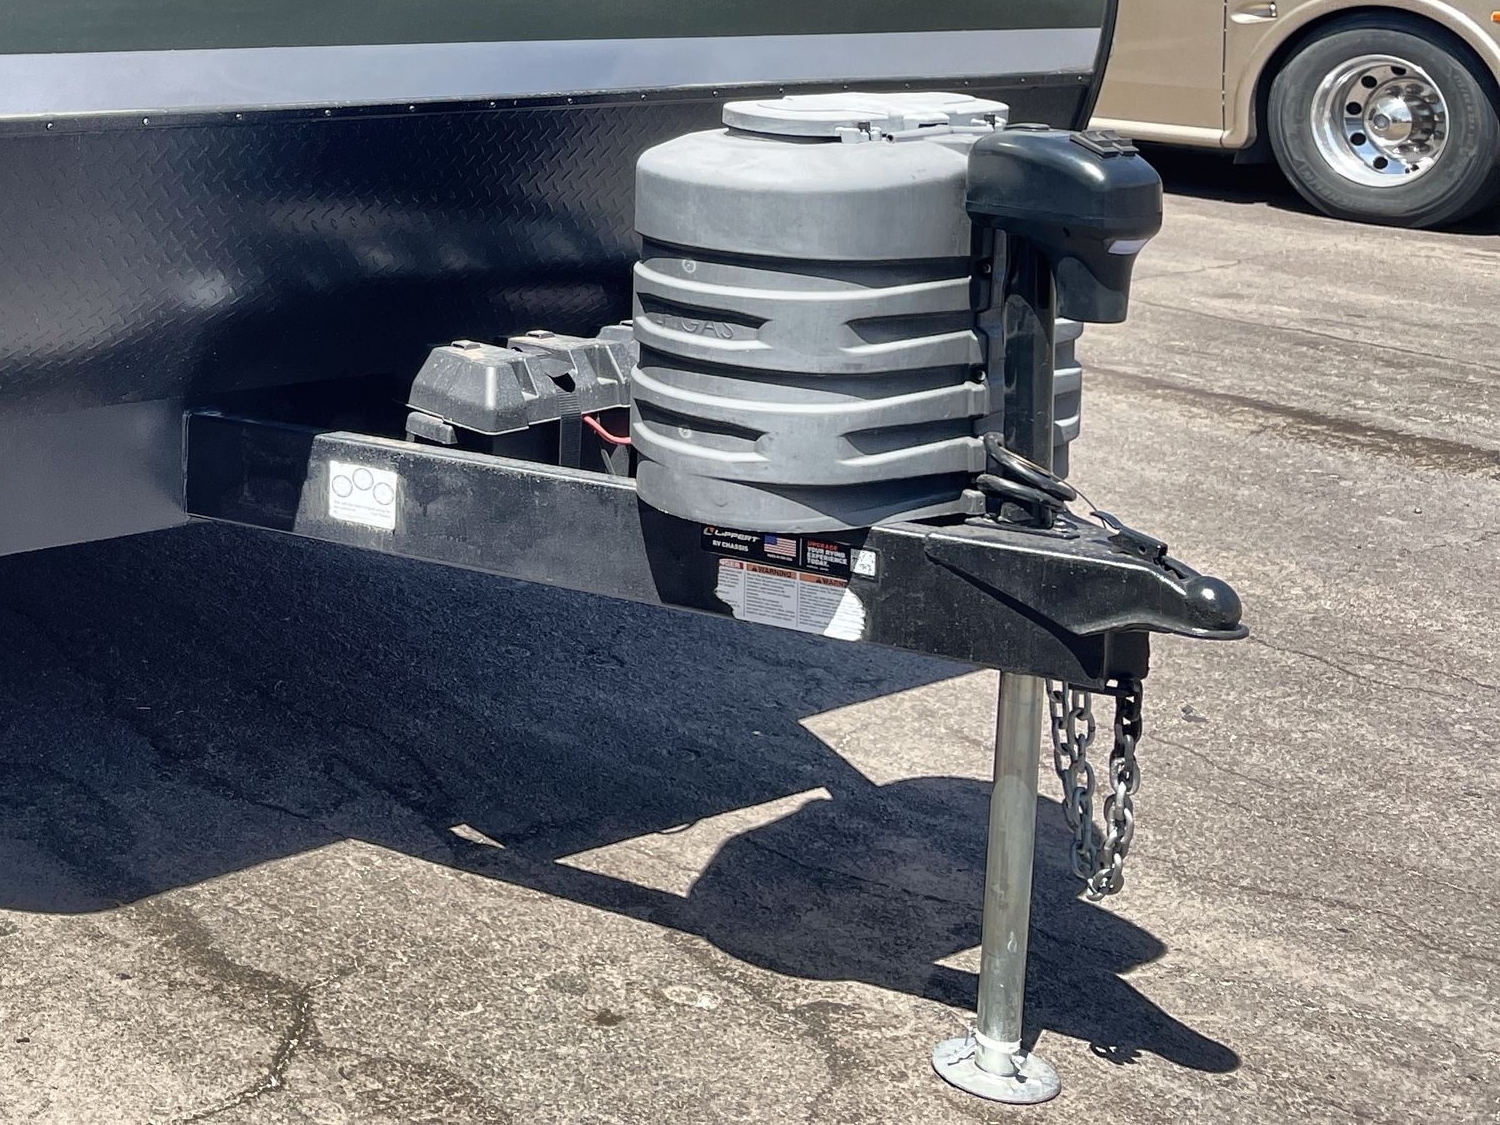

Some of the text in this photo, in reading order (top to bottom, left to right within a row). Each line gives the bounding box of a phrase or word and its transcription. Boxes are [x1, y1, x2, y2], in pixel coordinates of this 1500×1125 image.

[722, 542, 749, 552] CHASSIS
[807, 546, 824, 555] YOUR
[807, 552, 848, 565] EXPERIENCE
[757, 566, 791, 578] WARNING
[821, 577, 846, 587] WARN
